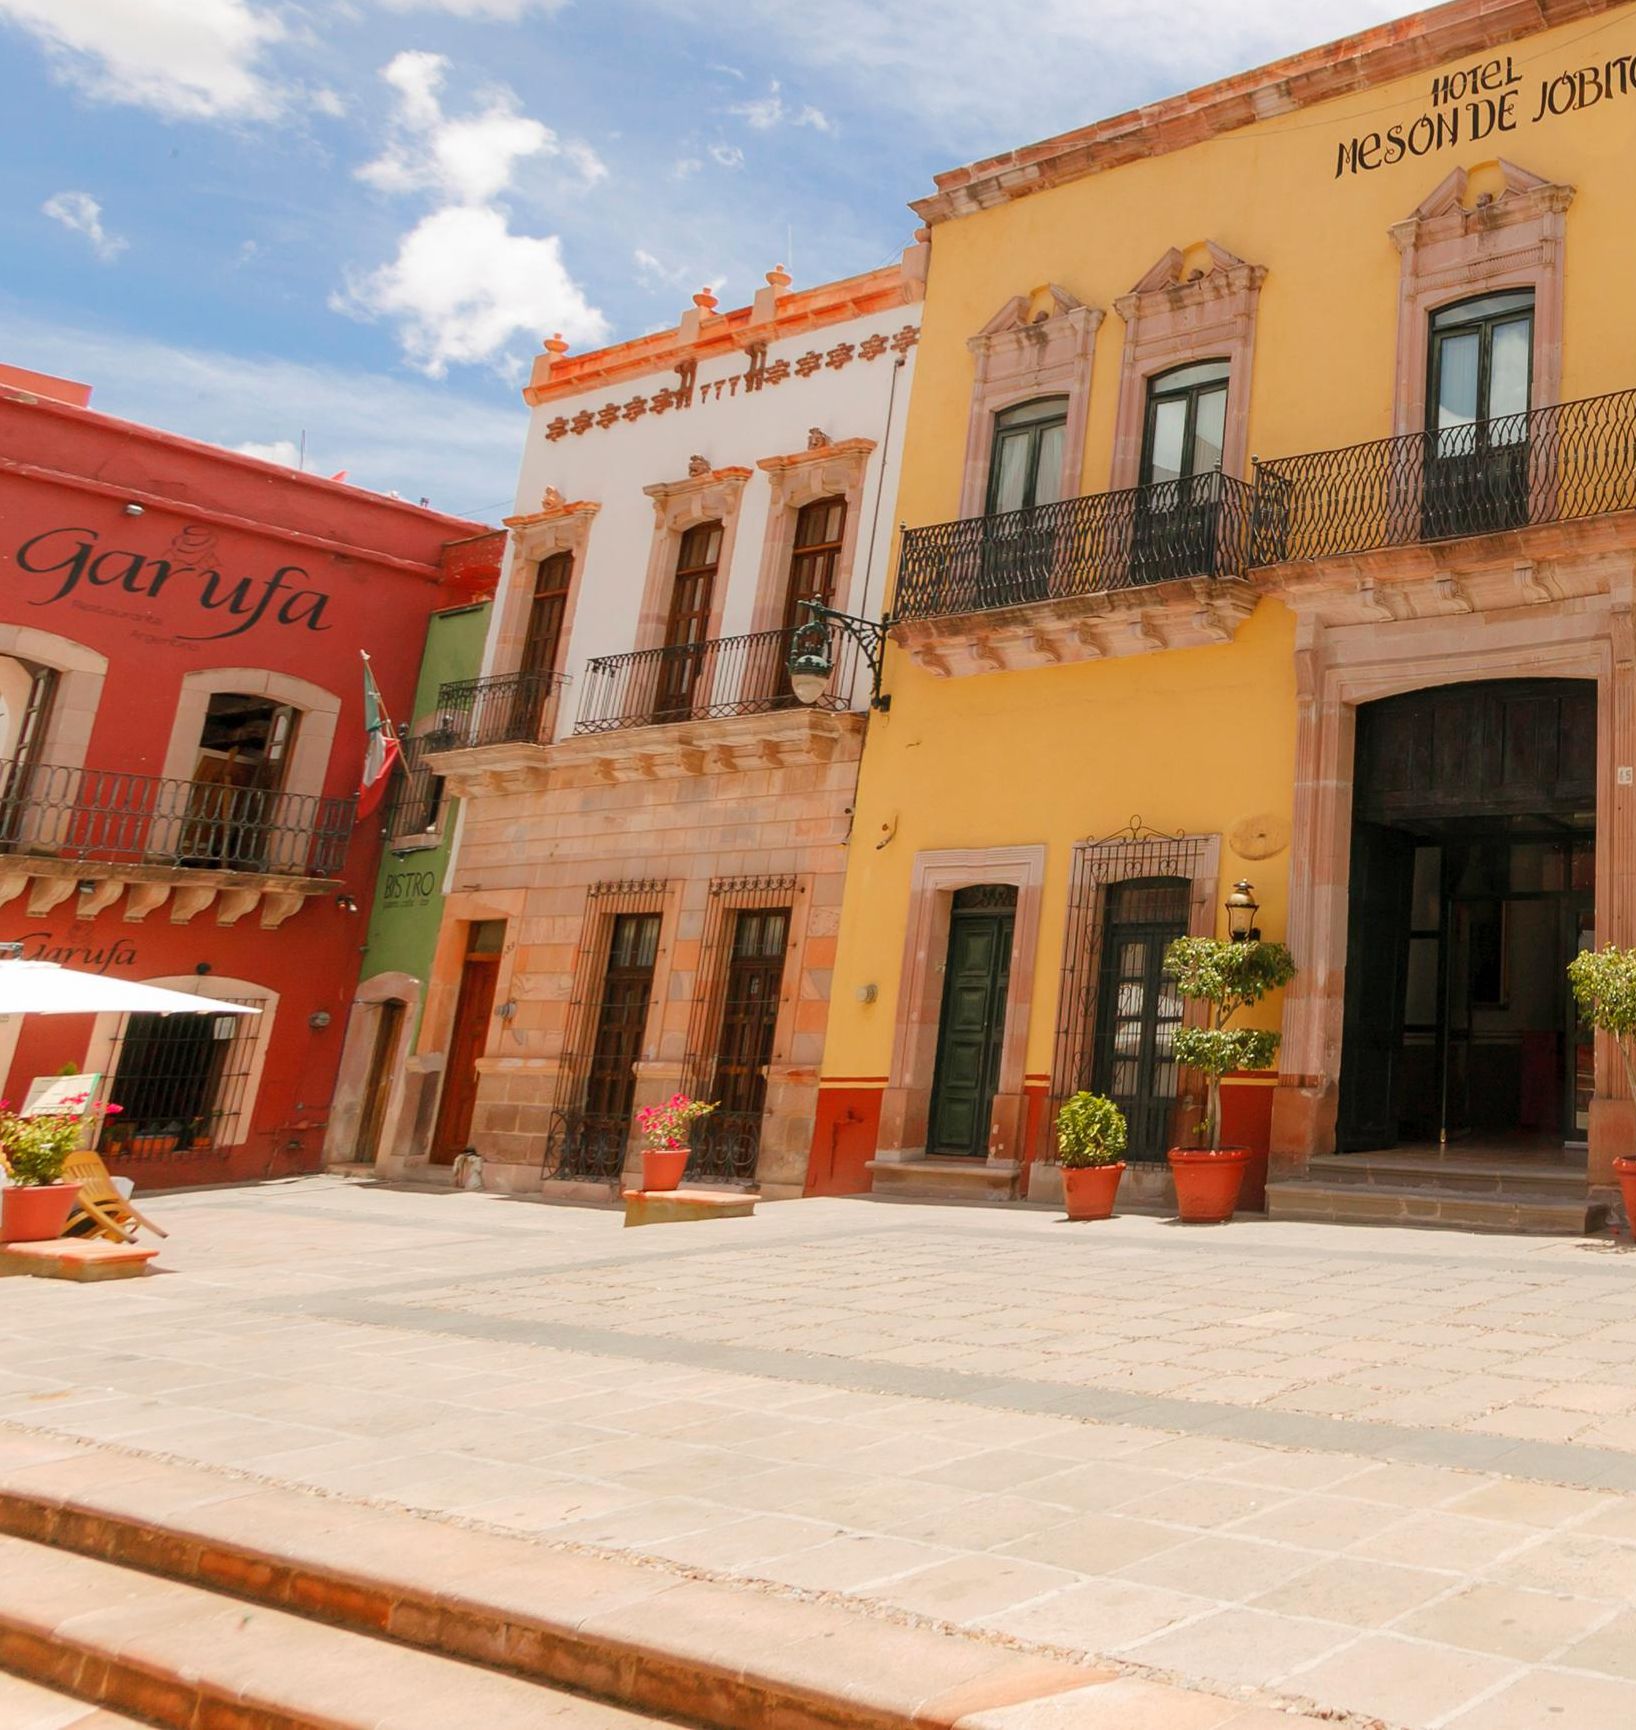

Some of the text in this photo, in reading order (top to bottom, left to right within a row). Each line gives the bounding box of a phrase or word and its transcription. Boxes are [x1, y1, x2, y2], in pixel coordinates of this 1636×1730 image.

[1431, 56, 1523, 107] HOTEL
[1466, 89, 1519, 142] DE
[16, 527, 334, 640] Garufa
[384, 871, 435, 899] BISTRO
